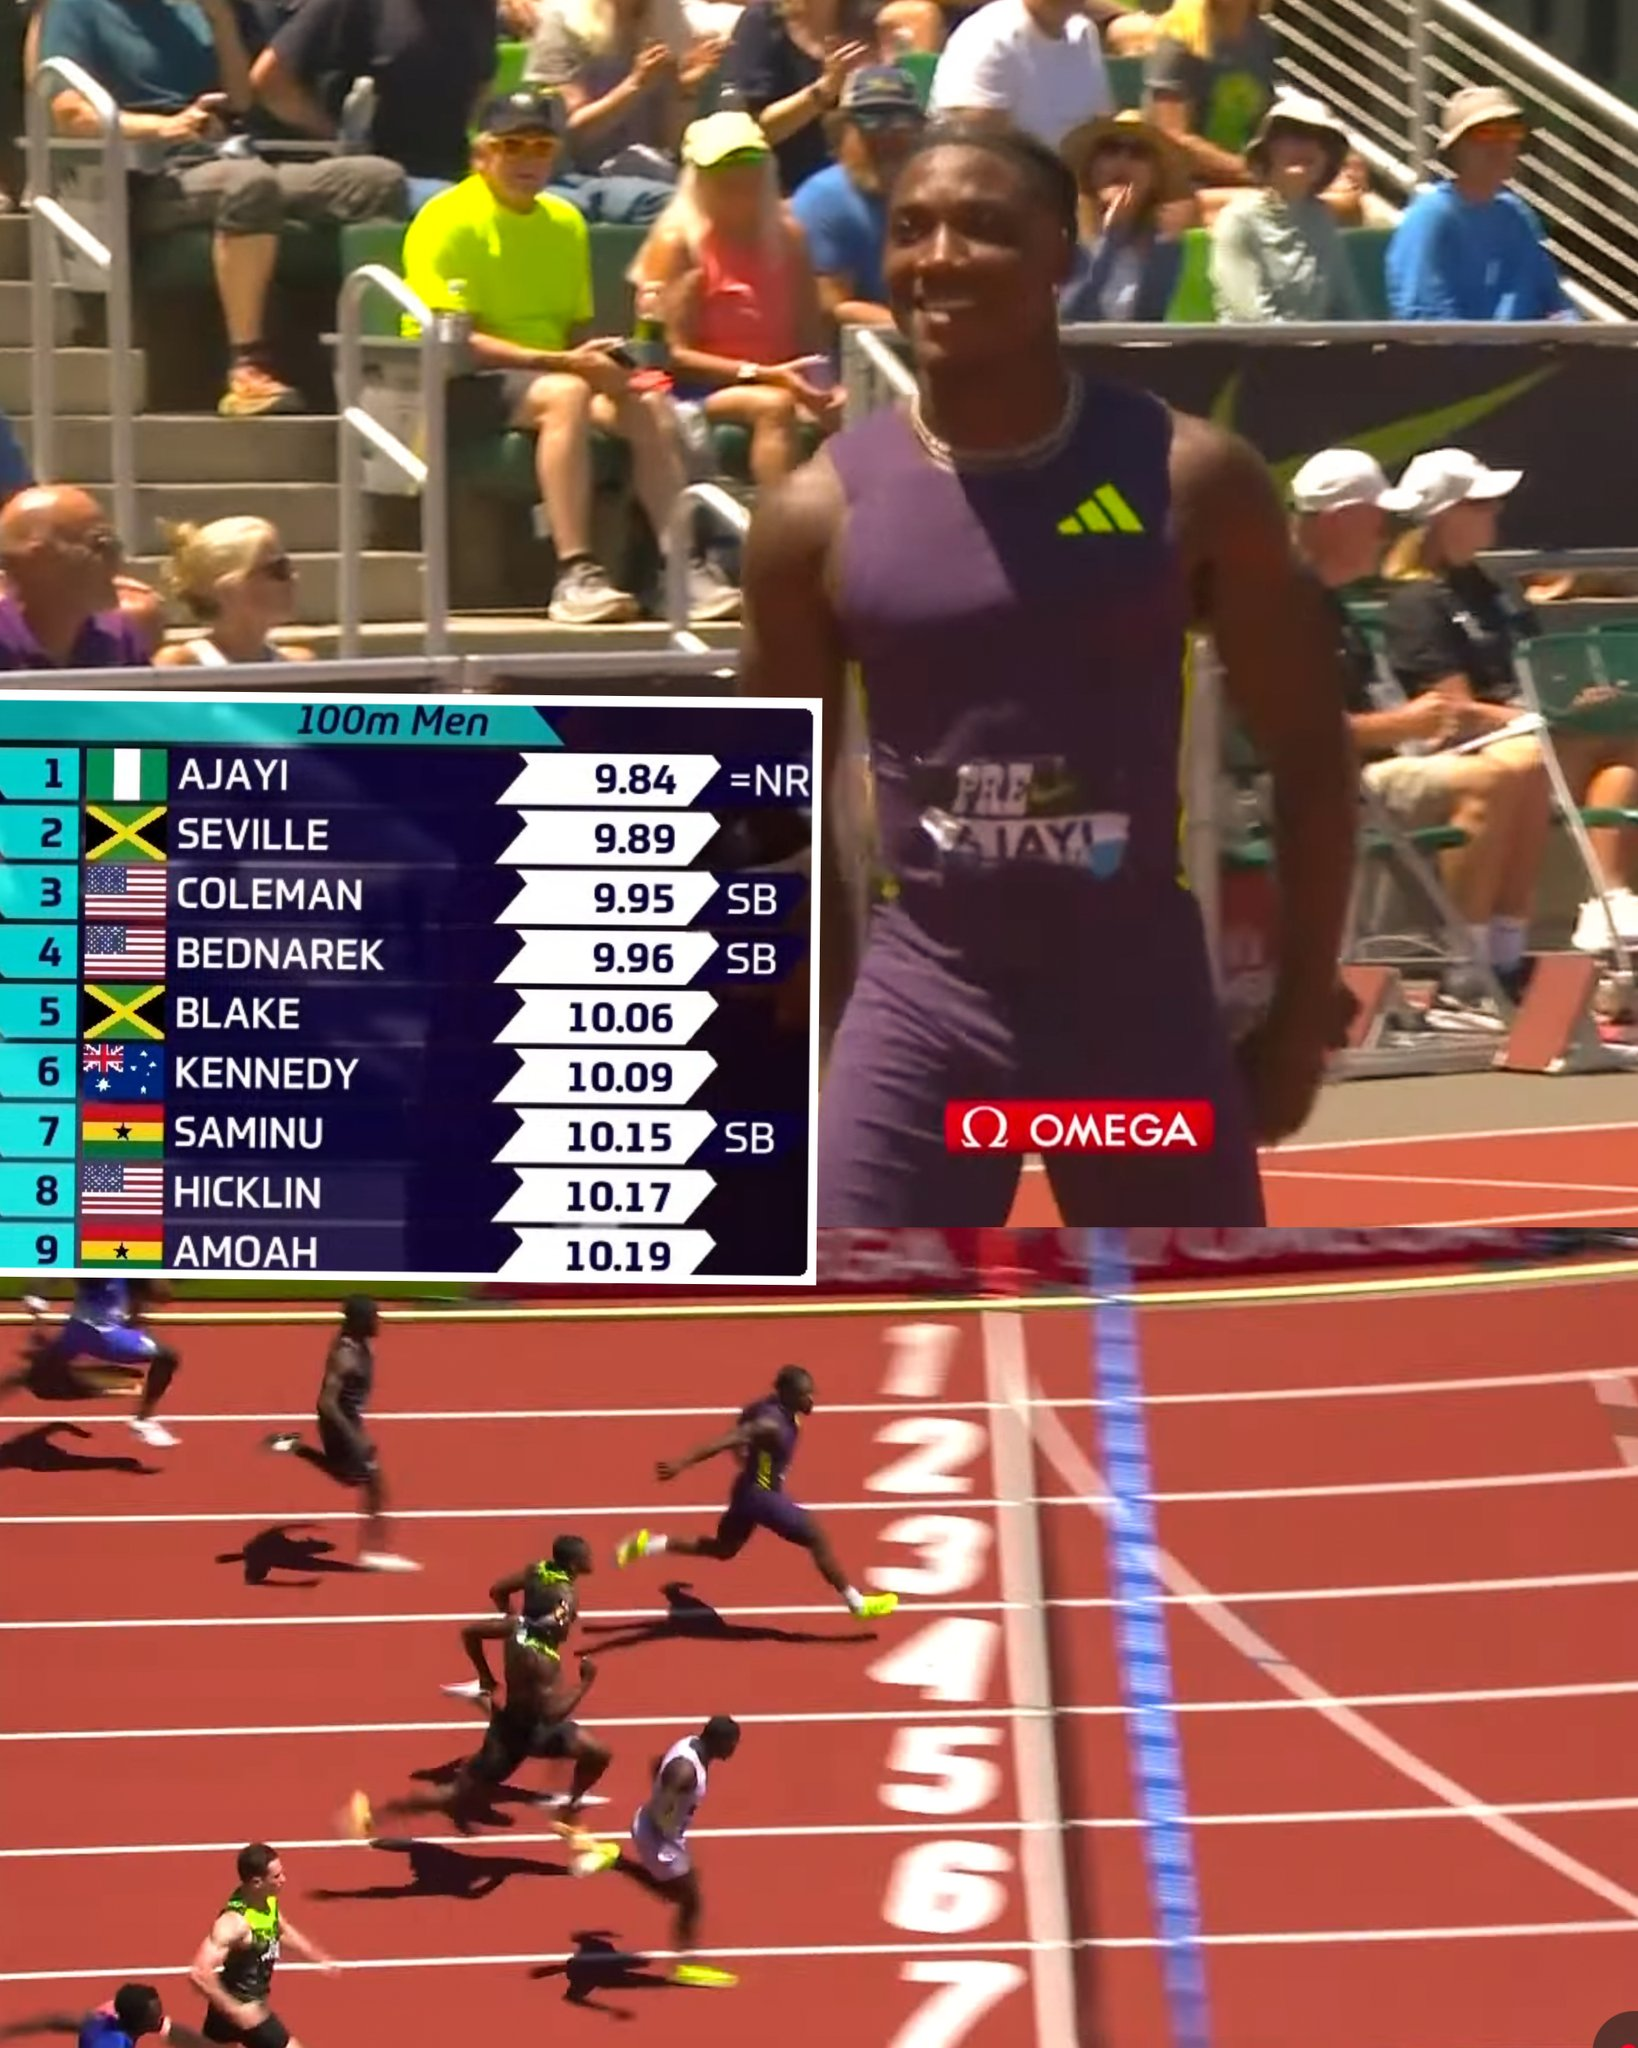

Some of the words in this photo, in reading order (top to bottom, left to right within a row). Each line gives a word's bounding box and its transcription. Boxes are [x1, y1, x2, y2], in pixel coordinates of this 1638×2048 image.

[953, 763, 1035, 817] PRE
[880, 1323, 961, 1398] 1
[865, 1417, 987, 1494] 2
[866, 1515, 992, 1595] 3
[866, 1616, 1000, 1702] 4
[877, 1726, 1003, 1815] 5
[882, 1840, 1014, 1934] 6
[887, 1960, 1027, 2048] 7
